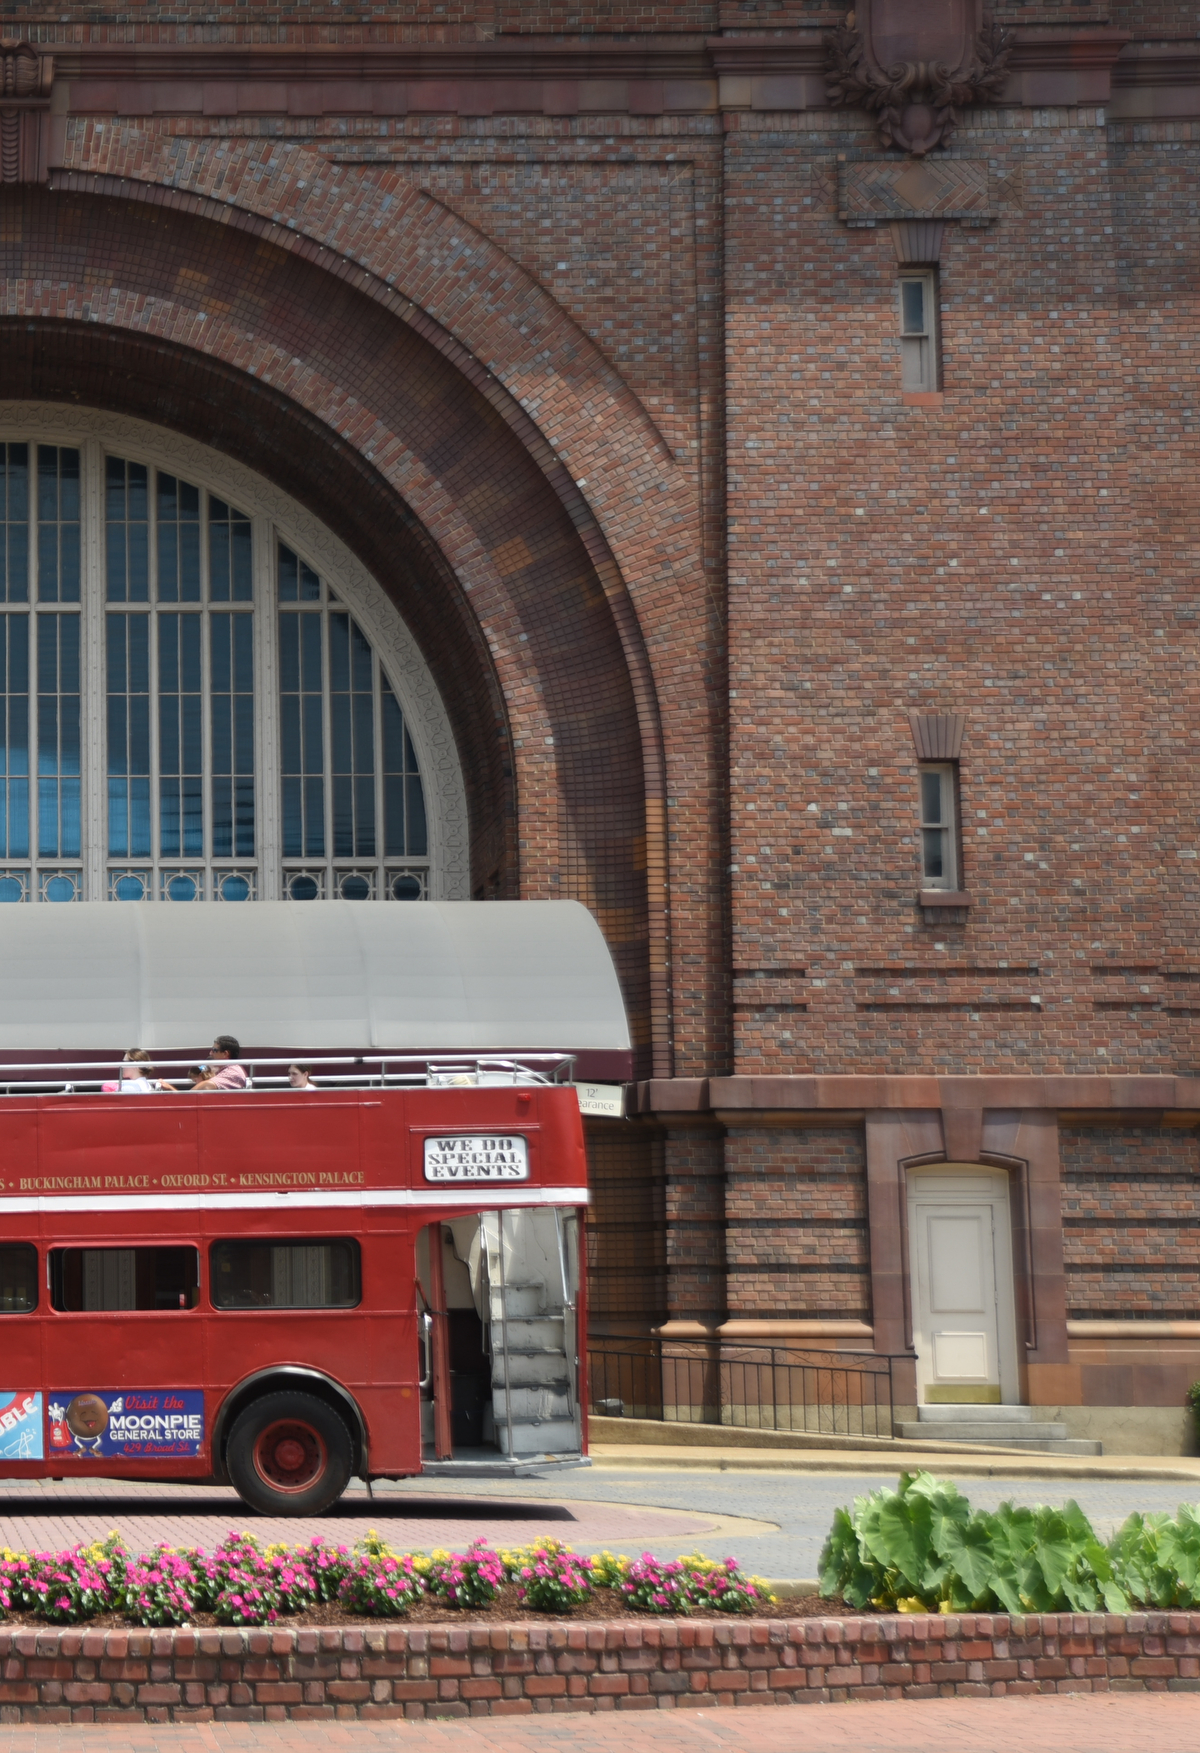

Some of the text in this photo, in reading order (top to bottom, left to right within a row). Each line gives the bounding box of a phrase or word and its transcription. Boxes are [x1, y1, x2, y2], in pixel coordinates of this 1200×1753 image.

[586, 1088, 599, 1098] 12'
[578, 1100, 615, 1111] earance
[434, 1138, 513, 1152] WE DO
[428, 1152, 522, 1165] SPECIAL
[431, 1165, 521, 1178] EVENTS
[19, 1176, 101, 1190] BUCKINGHAM
[104, 1175, 150, 1188] PALACE
[161, 1174, 210, 1187] OXFORD
[212, 1173, 228, 1186] ST.
[239, 1172, 316, 1185] KENSINGTON
[318, 1171, 365, 1184] PALACE
[125, 1395, 185, 1410] Visit the
[110, 1415, 201, 1430] MOONPIE
[109, 1429, 200, 1440] GENERAL STORE
[123, 1443, 142, 1453] 429
[143, 1443, 175, 1453] Broad
